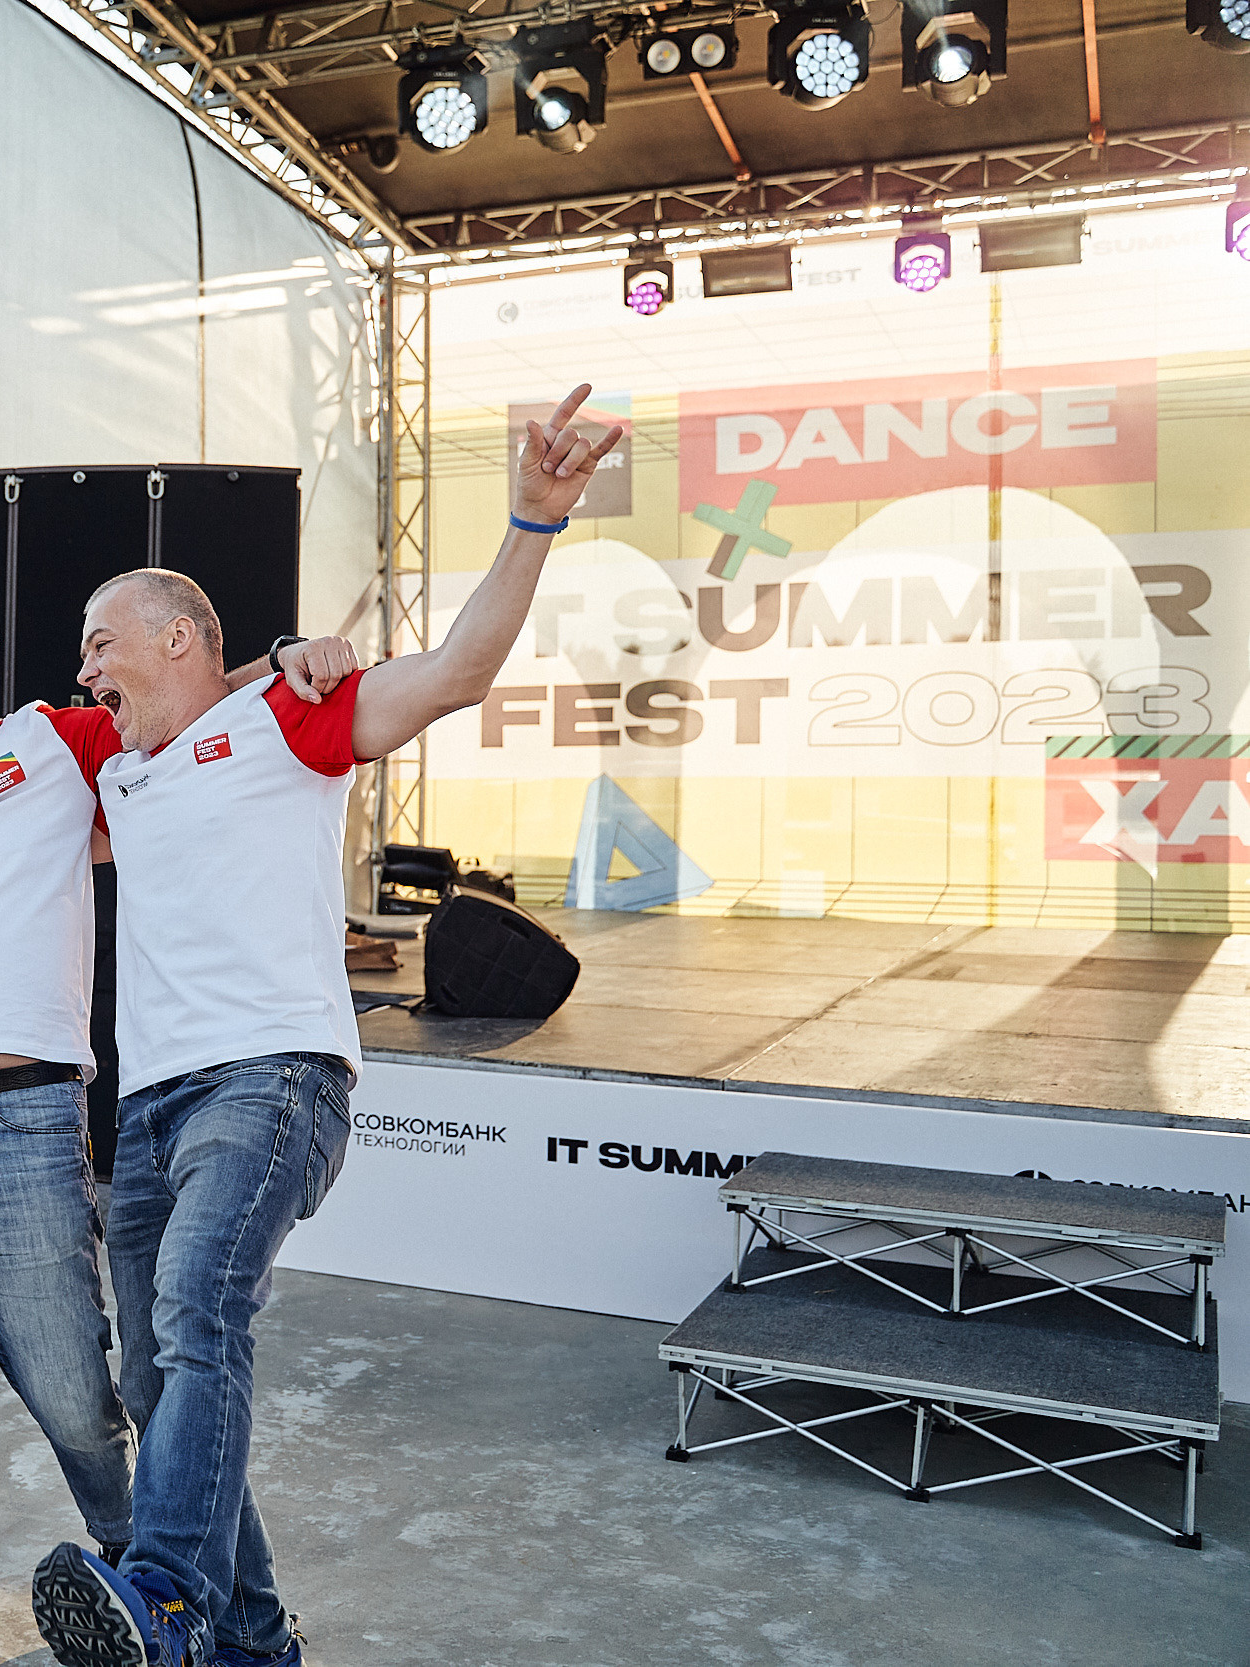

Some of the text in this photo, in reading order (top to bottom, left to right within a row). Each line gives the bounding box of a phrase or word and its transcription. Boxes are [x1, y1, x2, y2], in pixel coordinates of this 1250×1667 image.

[715, 385, 1118, 475] DANCE
[613, 563, 1212, 657] SUMMER
[481, 663, 1213, 748] FEST 2023
[198, 750, 219, 761] 2023
[353, 1112, 507, 1143] СОВКОМБАНК
[354, 1133, 466, 1156] ТЕХНОЛОГИИ
[546, 1136, 758, 1181] IT SUMM
